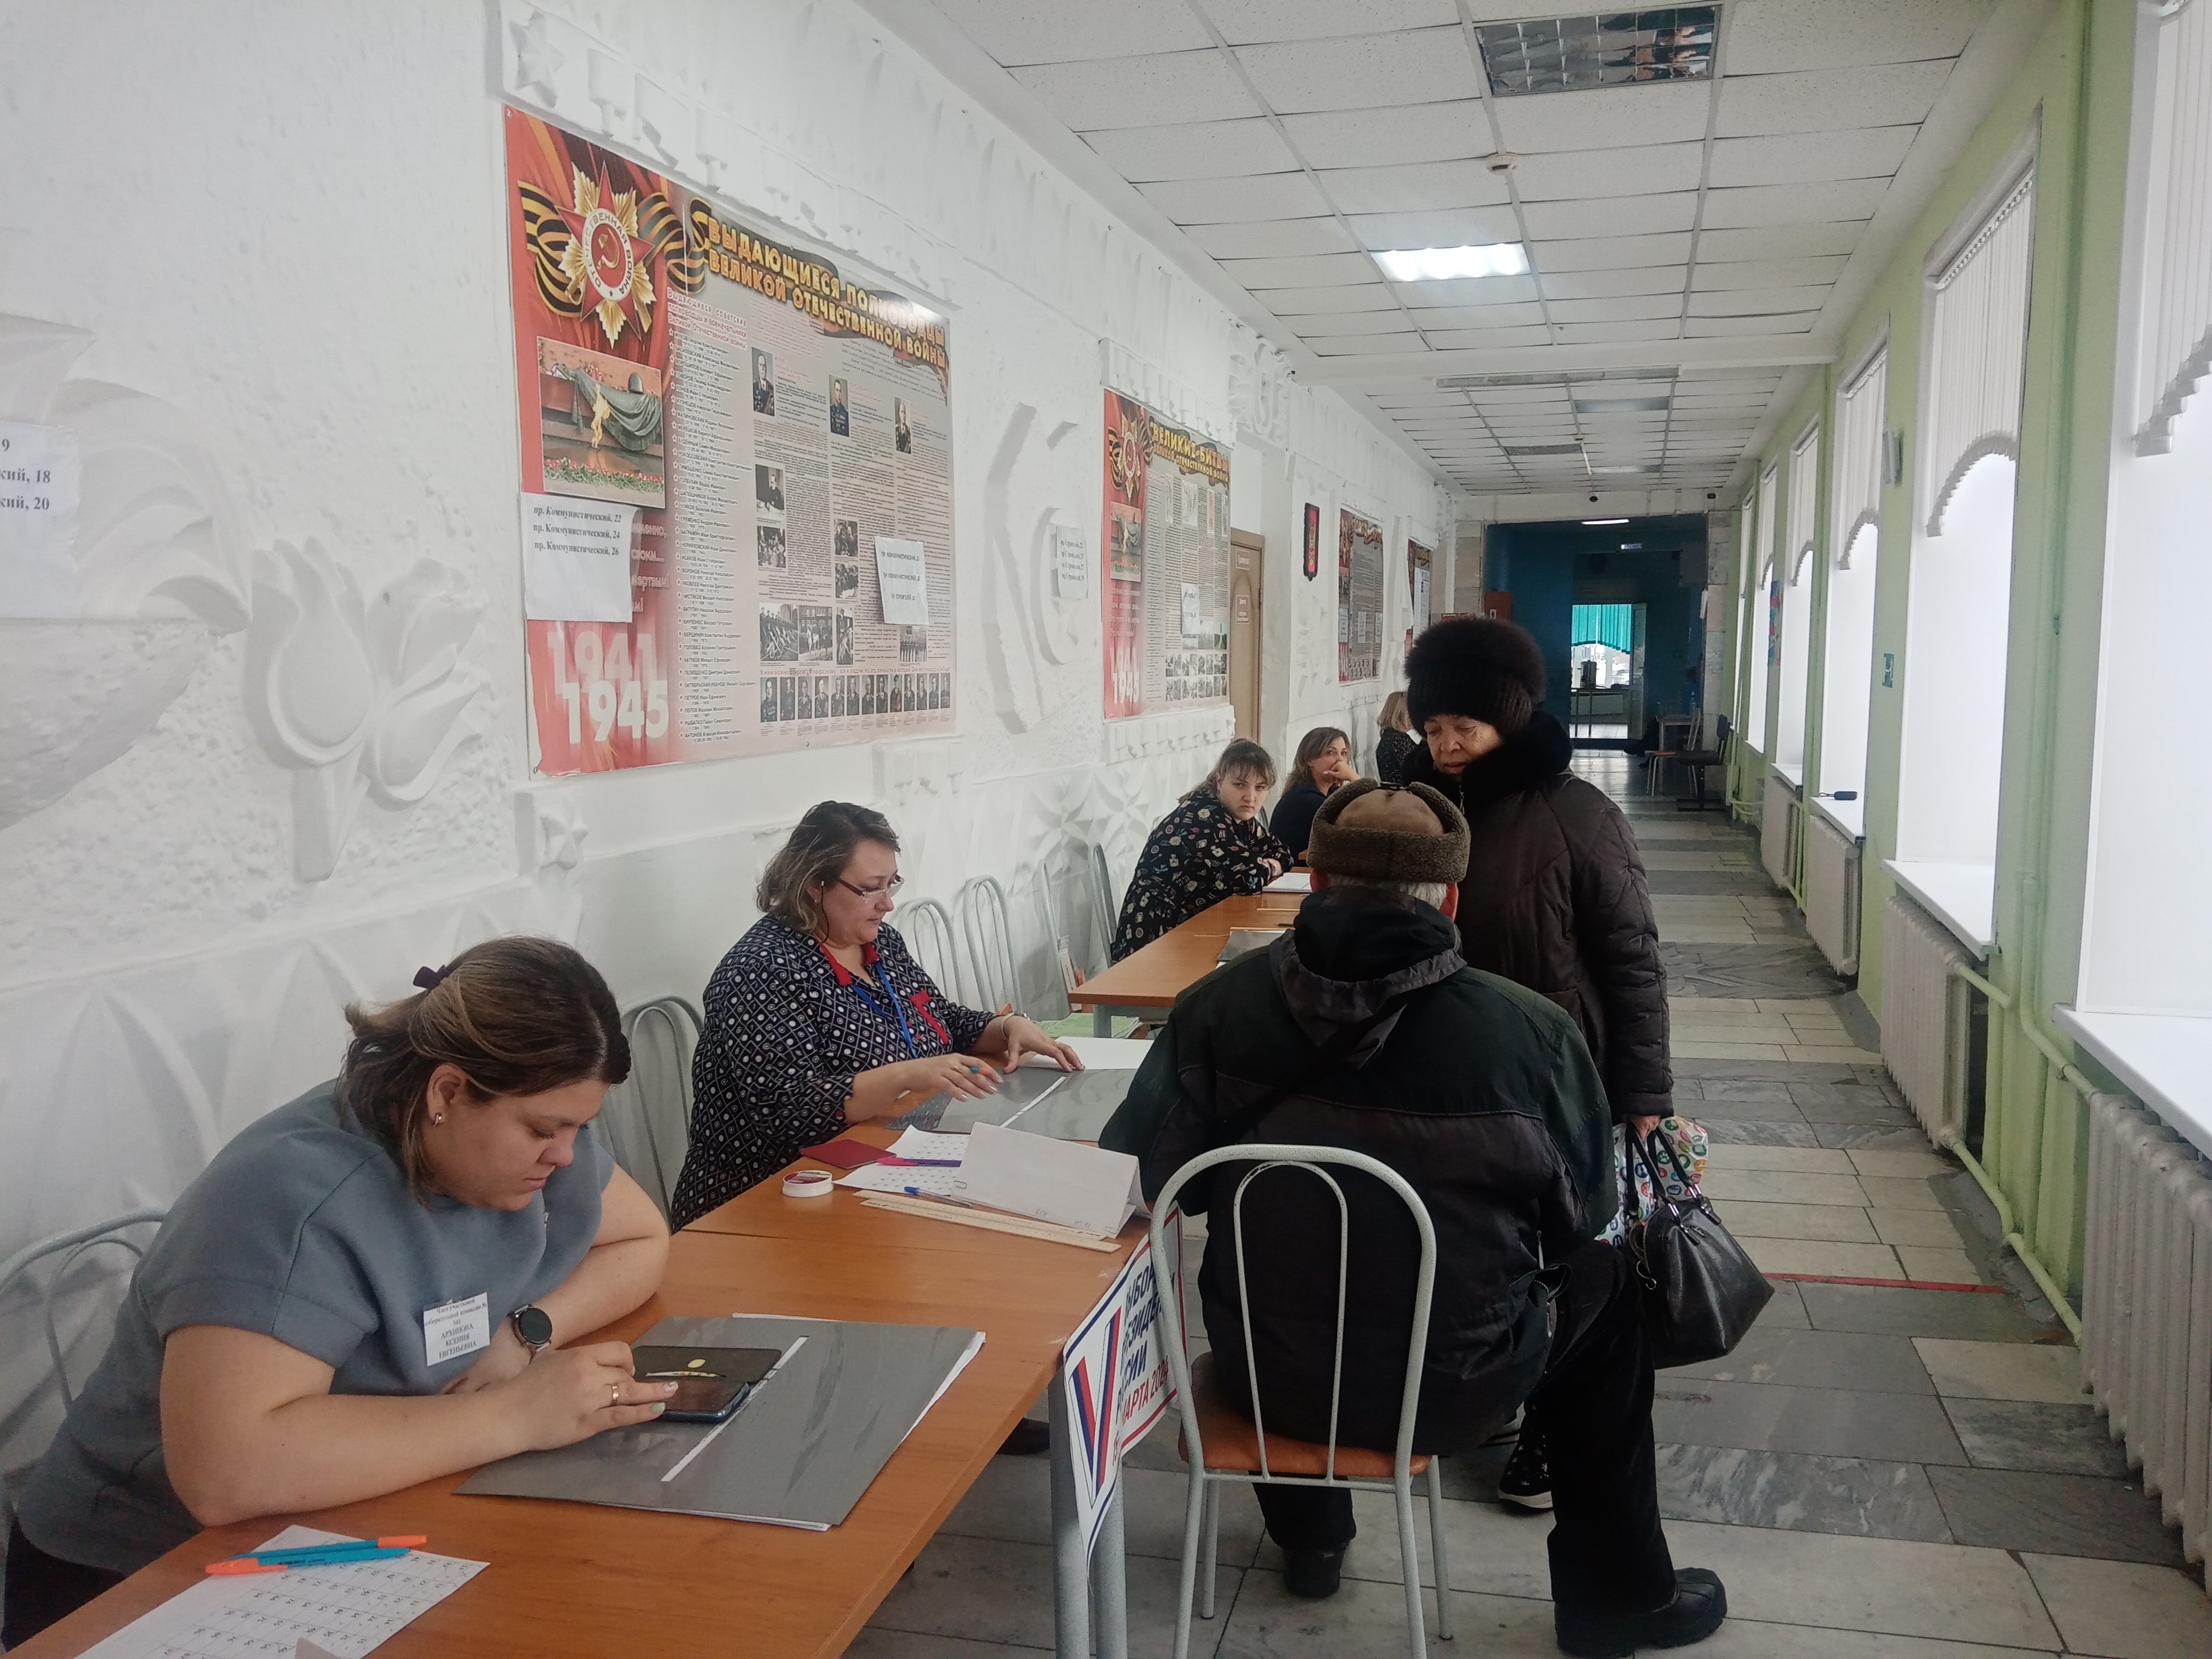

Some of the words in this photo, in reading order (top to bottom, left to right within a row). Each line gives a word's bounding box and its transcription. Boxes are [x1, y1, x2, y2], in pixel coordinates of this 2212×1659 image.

[619, 250, 632, 295] ВОЙНА
[708, 217, 840, 300] ВЫДАЮЩИЕСЯ
[847, 283, 945, 347] ПОЛКОВОДЦЫ
[667, 288, 711, 313] Выдающиеся
[716, 309, 747, 326] советские
[709, 248, 786, 303] ВЕЛИКОЙ
[792, 287, 902, 349] ОТЕЧЕСТВЕННОЙ
[906, 336, 945, 370] ВОЙНЫ
[1, 438, 10, 451] 9
[1153, 424, 1196, 459] ВЕЛИКИЕ
[1200, 446, 1229, 472] БИТВЫ
[36, 470, 51, 483] 18
[33, 497, 49, 510] 20
[534, 507, 544, 516] пр.
[546, 506, 613, 523] Коммунистический,
[614, 514, 622, 523] 22
[533, 524, 544, 533] пр.
[546, 524, 611, 539] Коммунистический,
[534, 542, 546, 551] пр.
[547, 541, 610, 555] Коммунистический,
[547, 631, 657, 694] 1941
[1113, 672, 1139, 704] 1945
[563, 680, 669, 744] 1945
[1124, 1263, 1157, 1327] ВЫБОР
[441, 1323, 473, 1339] АРХИПОВА
[446, 1333, 470, 1347] КСЕНИЯ
[439, 1340, 476, 1359] ЕВГЕНЬЕВНА
[1150, 1355, 1168, 1400] 2024
